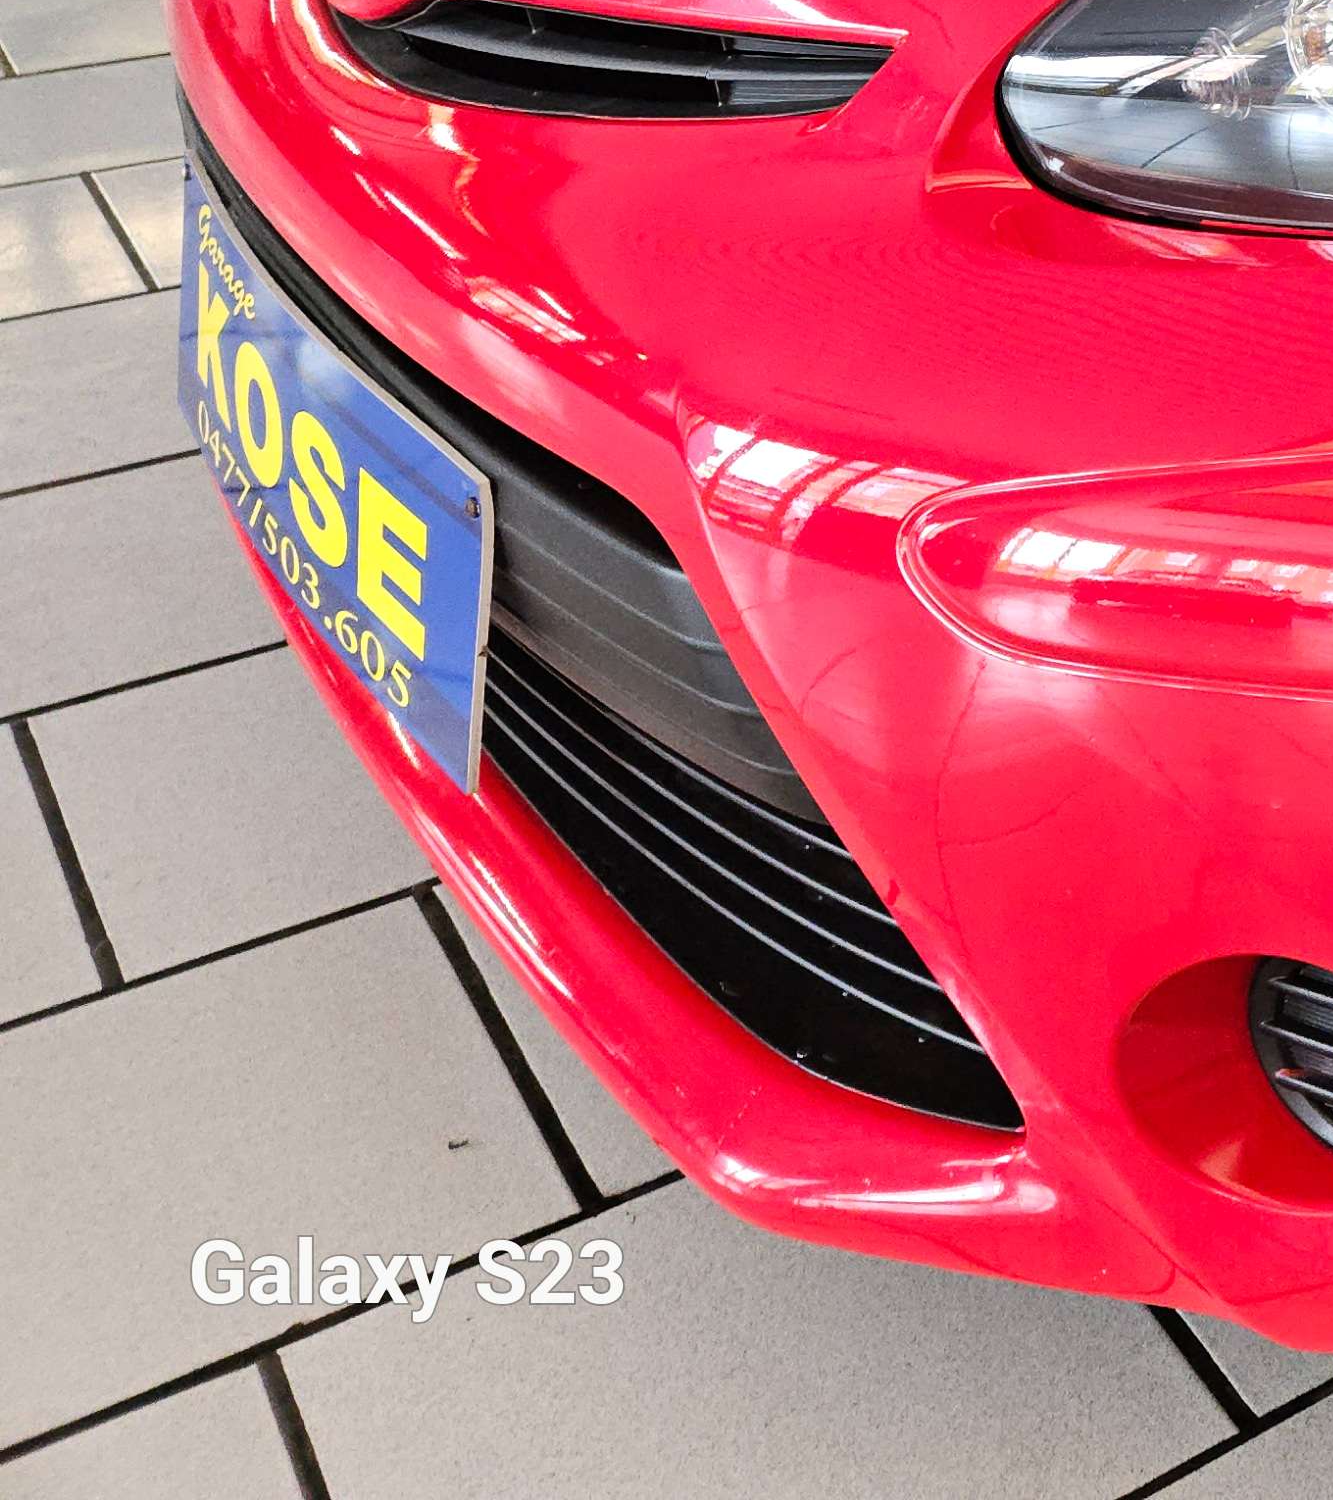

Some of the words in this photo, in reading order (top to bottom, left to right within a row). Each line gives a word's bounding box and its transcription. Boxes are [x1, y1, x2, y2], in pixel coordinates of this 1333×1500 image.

[198, 204, 256, 319] Garage
[197, 259, 428, 661] KOSE
[199, 401, 411, 707] 0477/503.605
